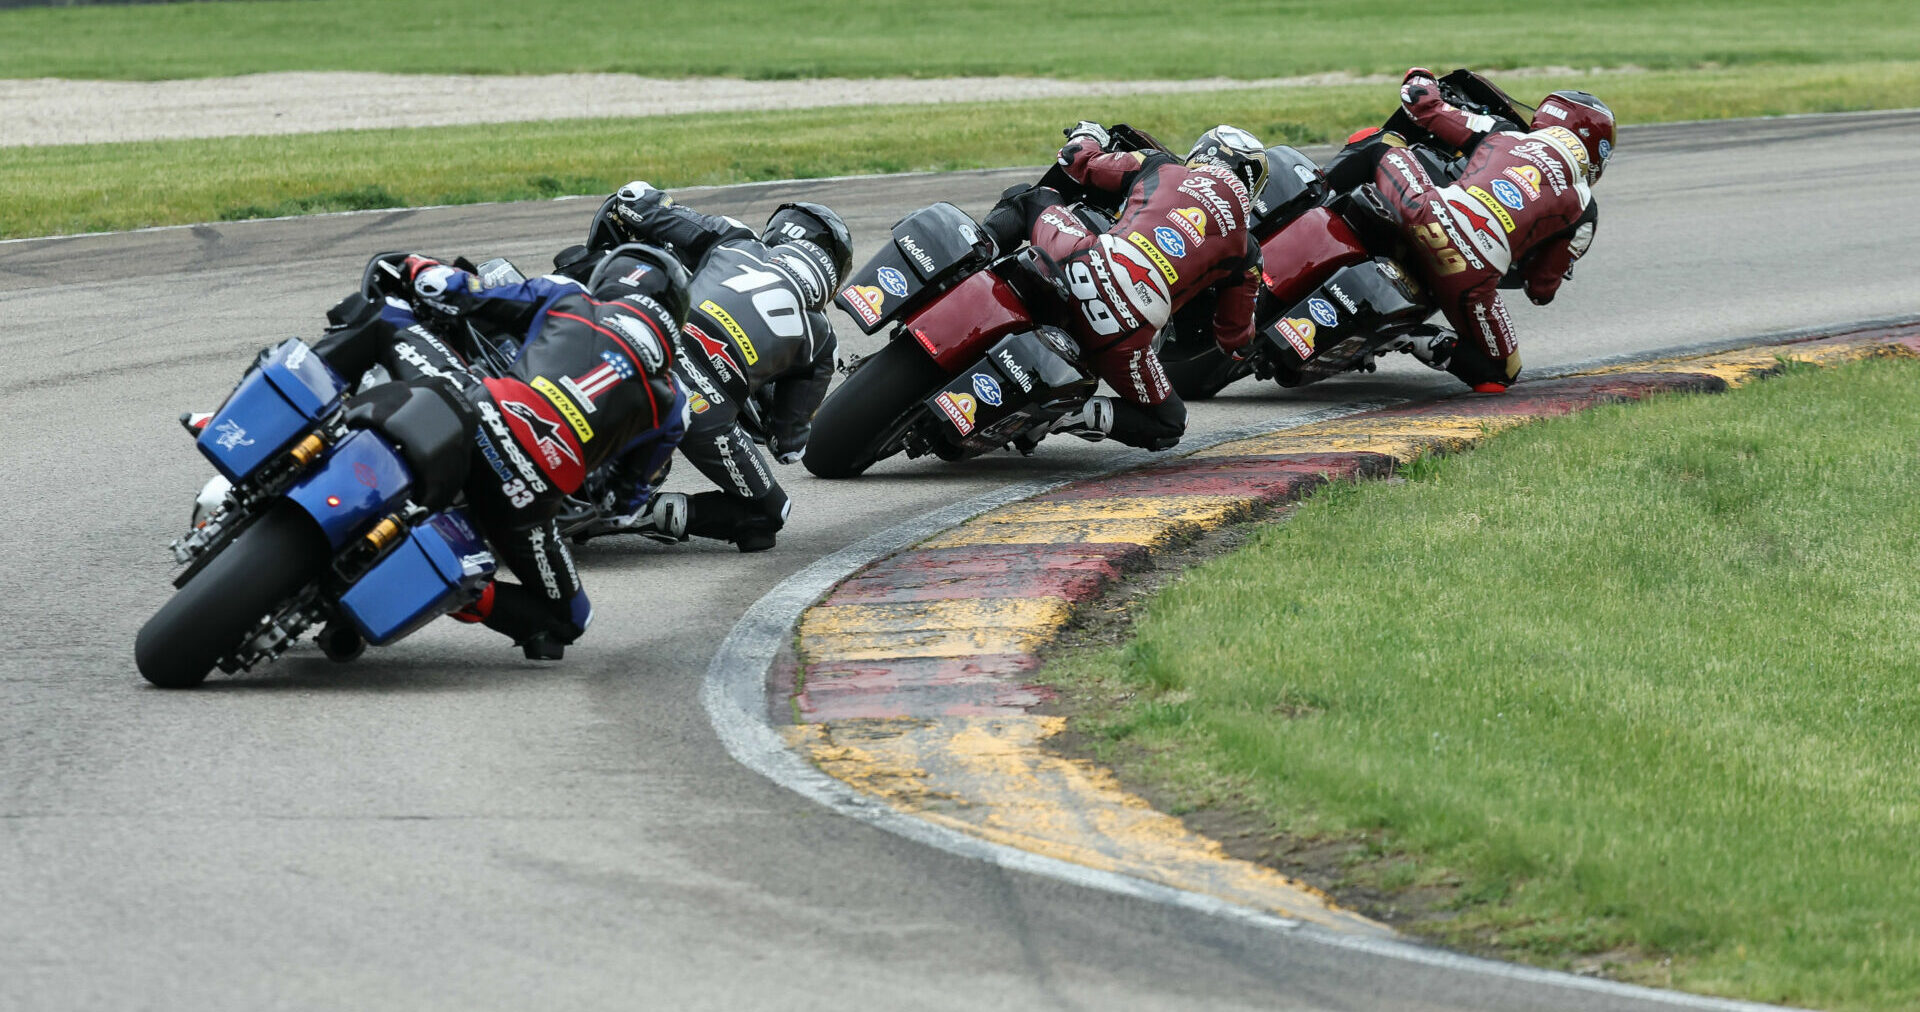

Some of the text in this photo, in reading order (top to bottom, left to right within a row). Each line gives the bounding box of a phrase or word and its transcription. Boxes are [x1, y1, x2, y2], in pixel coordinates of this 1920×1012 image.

[1508, 149, 1562, 197] MOTORCYCLE RACING
[1514, 142, 1569, 190] Indian
[1177, 185, 1228, 237] MOTORCYCLE RACING
[1183, 176, 1236, 231] Indian
[1478, 192, 1513, 230] DUNLOP
[780, 222, 807, 239] 10
[899, 235, 935, 273] Medallia
[1430, 200, 1485, 270] alpinestars
[618, 264, 653, 287] 1
[1140, 241, 1176, 280] DUNLOP
[720, 264, 804, 337] 10
[1065, 261, 1126, 335] 99
[1088, 249, 1139, 329] alpinestars
[1330, 283, 1358, 315] Medallia
[715, 311, 755, 359] DUNLOP
[559, 350, 635, 414] 1
[998, 349, 1033, 393] Medallia
[546, 386, 591, 439] DUNLOP
[478, 401, 548, 493] alpinestars
[502, 478, 535, 508] 33
